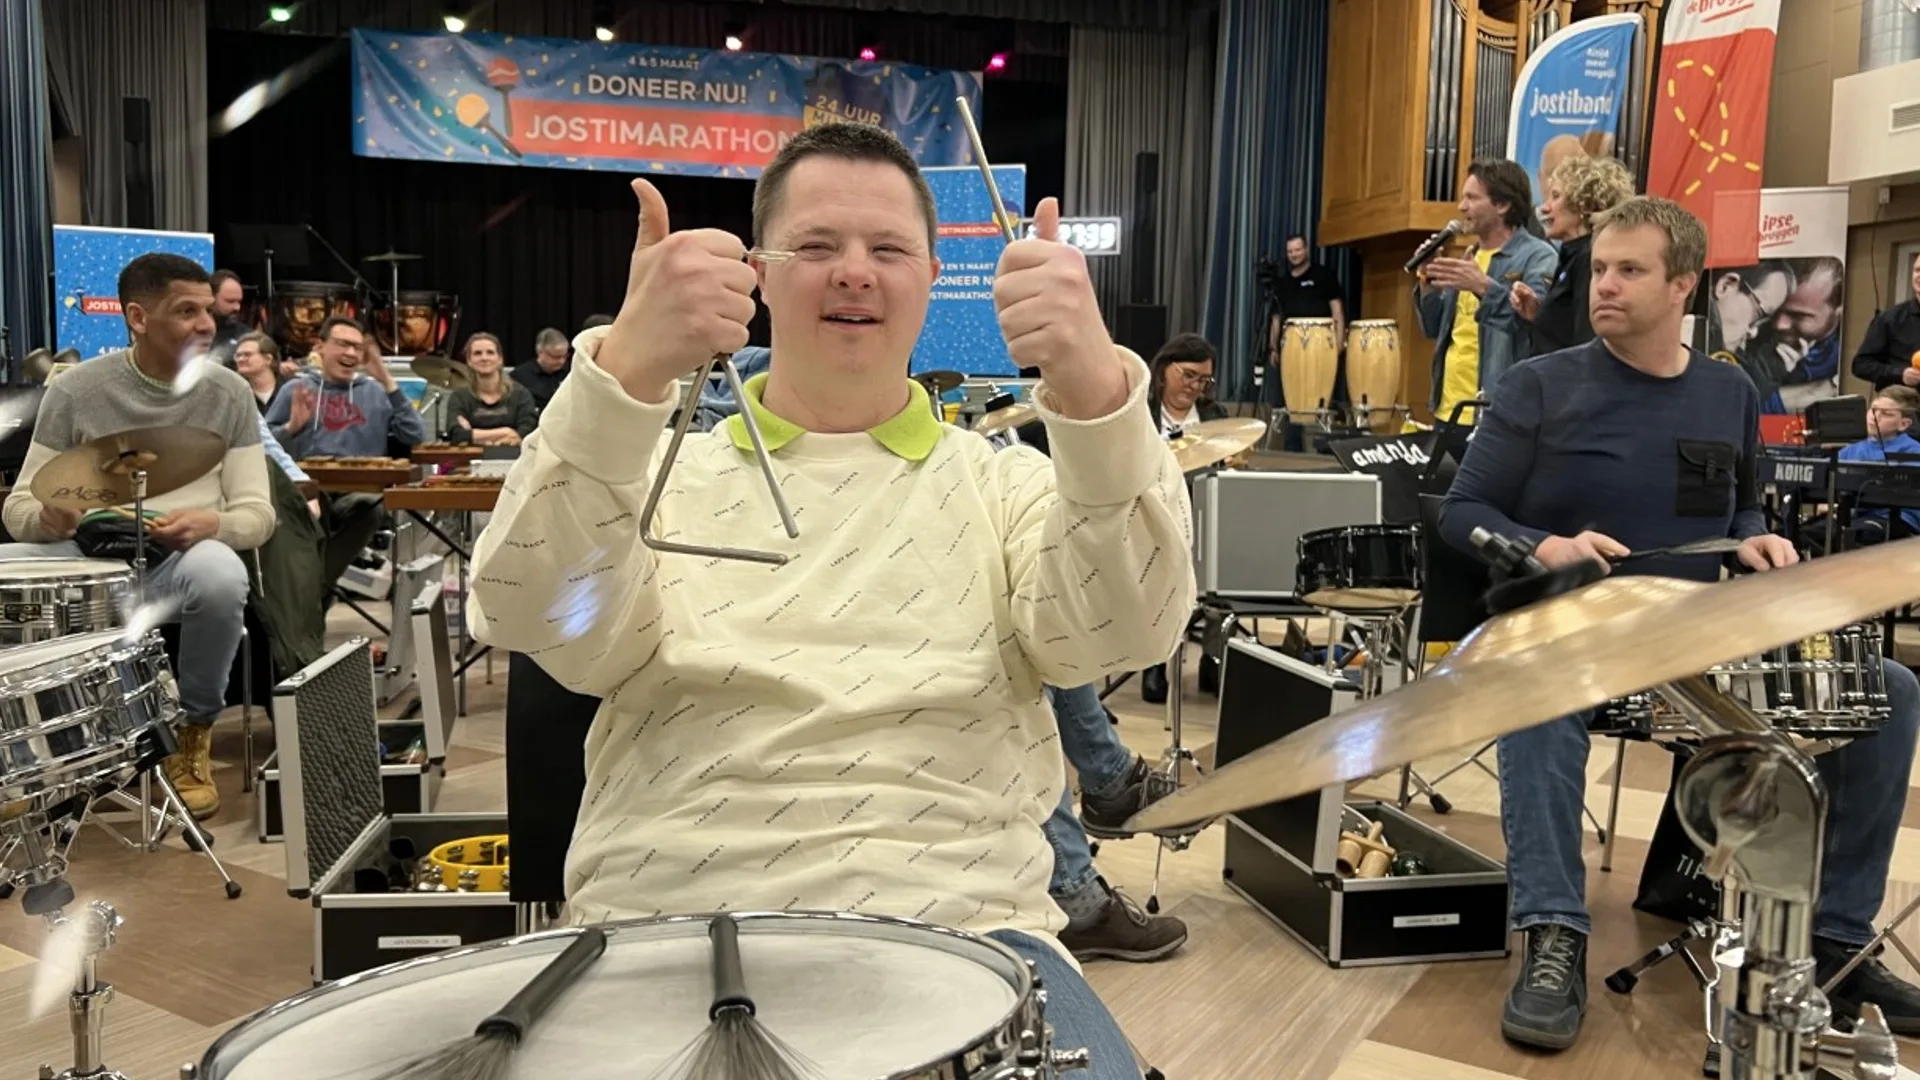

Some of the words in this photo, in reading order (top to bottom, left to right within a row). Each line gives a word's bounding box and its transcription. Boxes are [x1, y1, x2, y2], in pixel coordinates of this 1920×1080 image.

[660, 59, 700, 71] MAART
[588, 74, 696, 101] DONEER
[704, 82, 748, 104] NU!
[815, 95, 839, 113] 24
[844, 103, 882, 127] UUR
[1530, 87, 1613, 118] jostiband
[525, 115, 798, 153] JOSTIMARATHON
[1763, 213, 1793, 232] ipse
[930, 291, 993, 300] STIMARATHO
[1775, 462, 1814, 483] KORG
